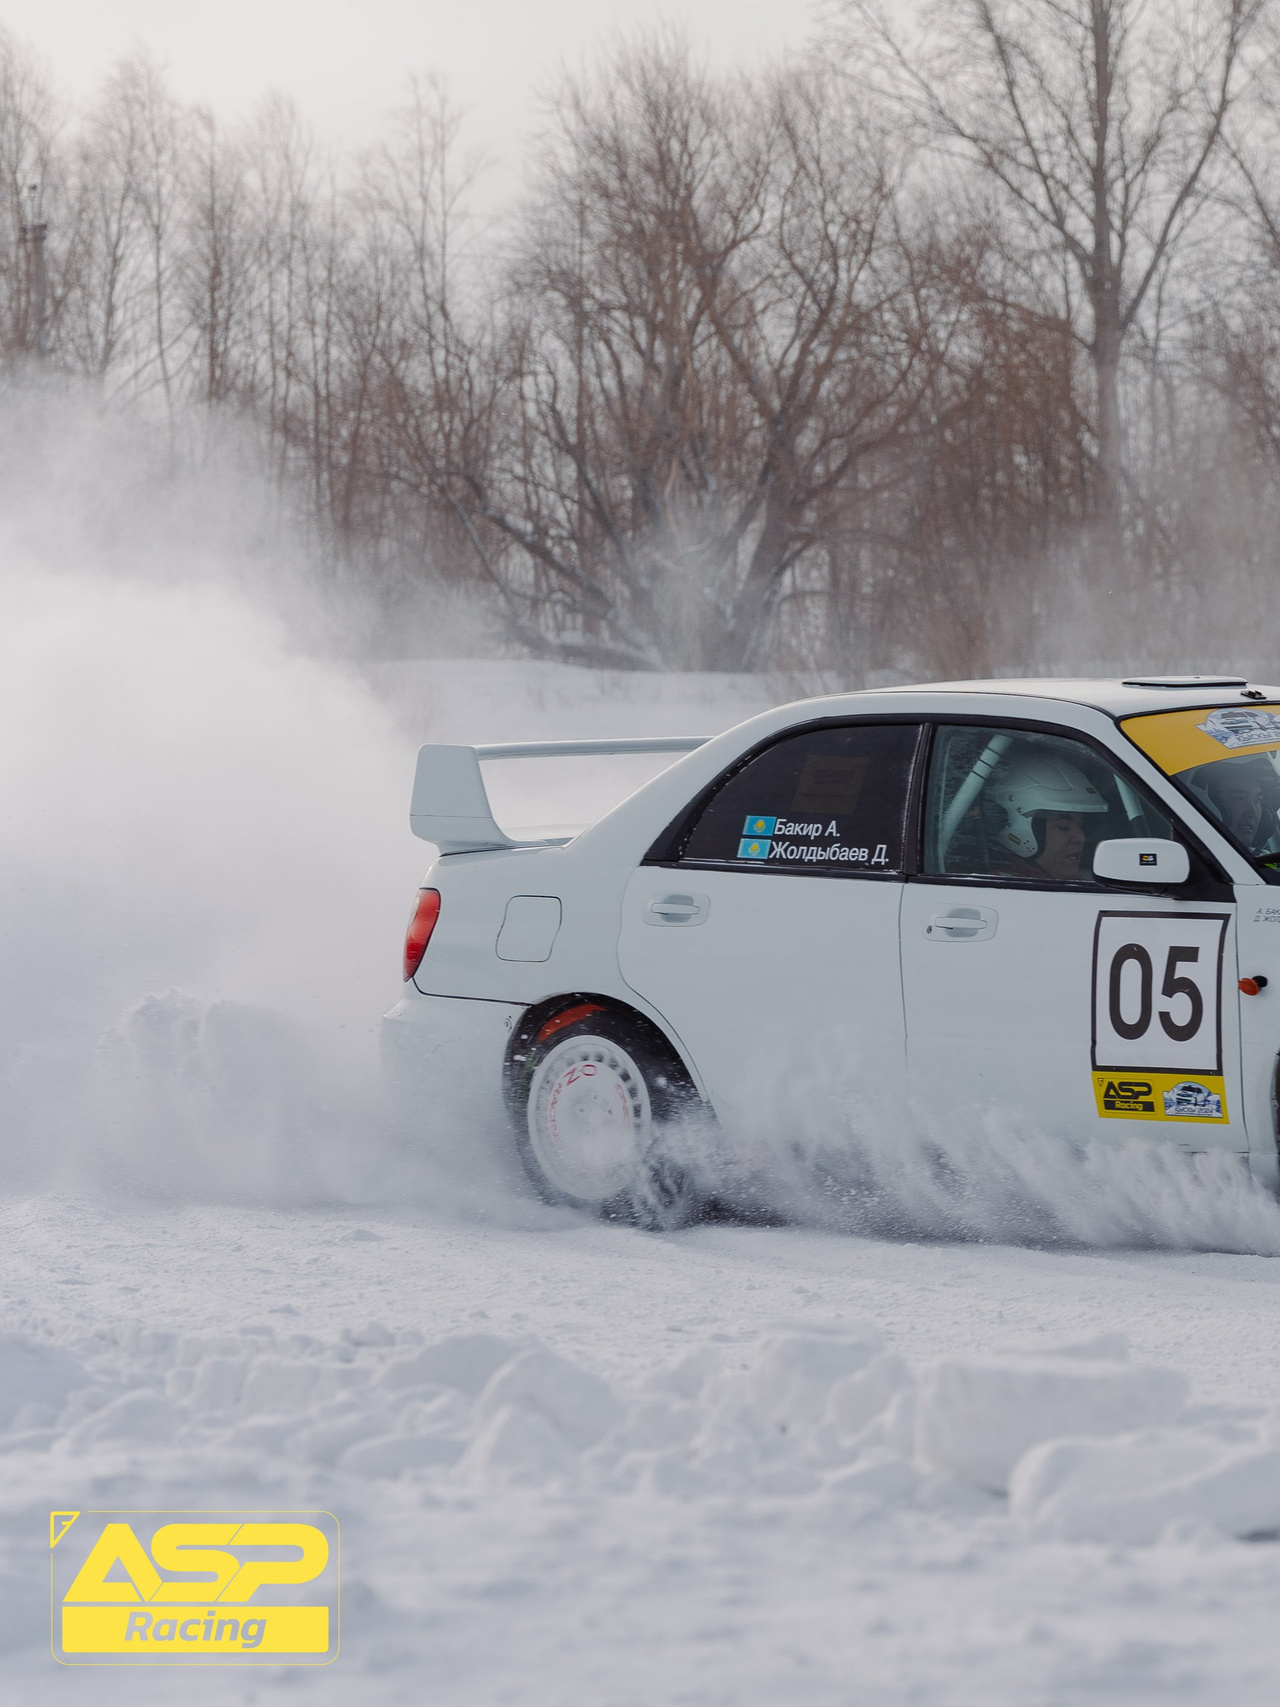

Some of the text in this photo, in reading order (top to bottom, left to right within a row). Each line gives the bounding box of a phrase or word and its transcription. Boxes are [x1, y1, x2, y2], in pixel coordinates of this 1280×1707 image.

[774, 818, 841, 840] Бакир А.
[769, 841, 890, 865] Жолдыбаев Д.
[1109, 943, 1204, 1043] 05
[1103, 1080, 1152, 1100] ASP
[1115, 1100, 1144, 1111] Racing
